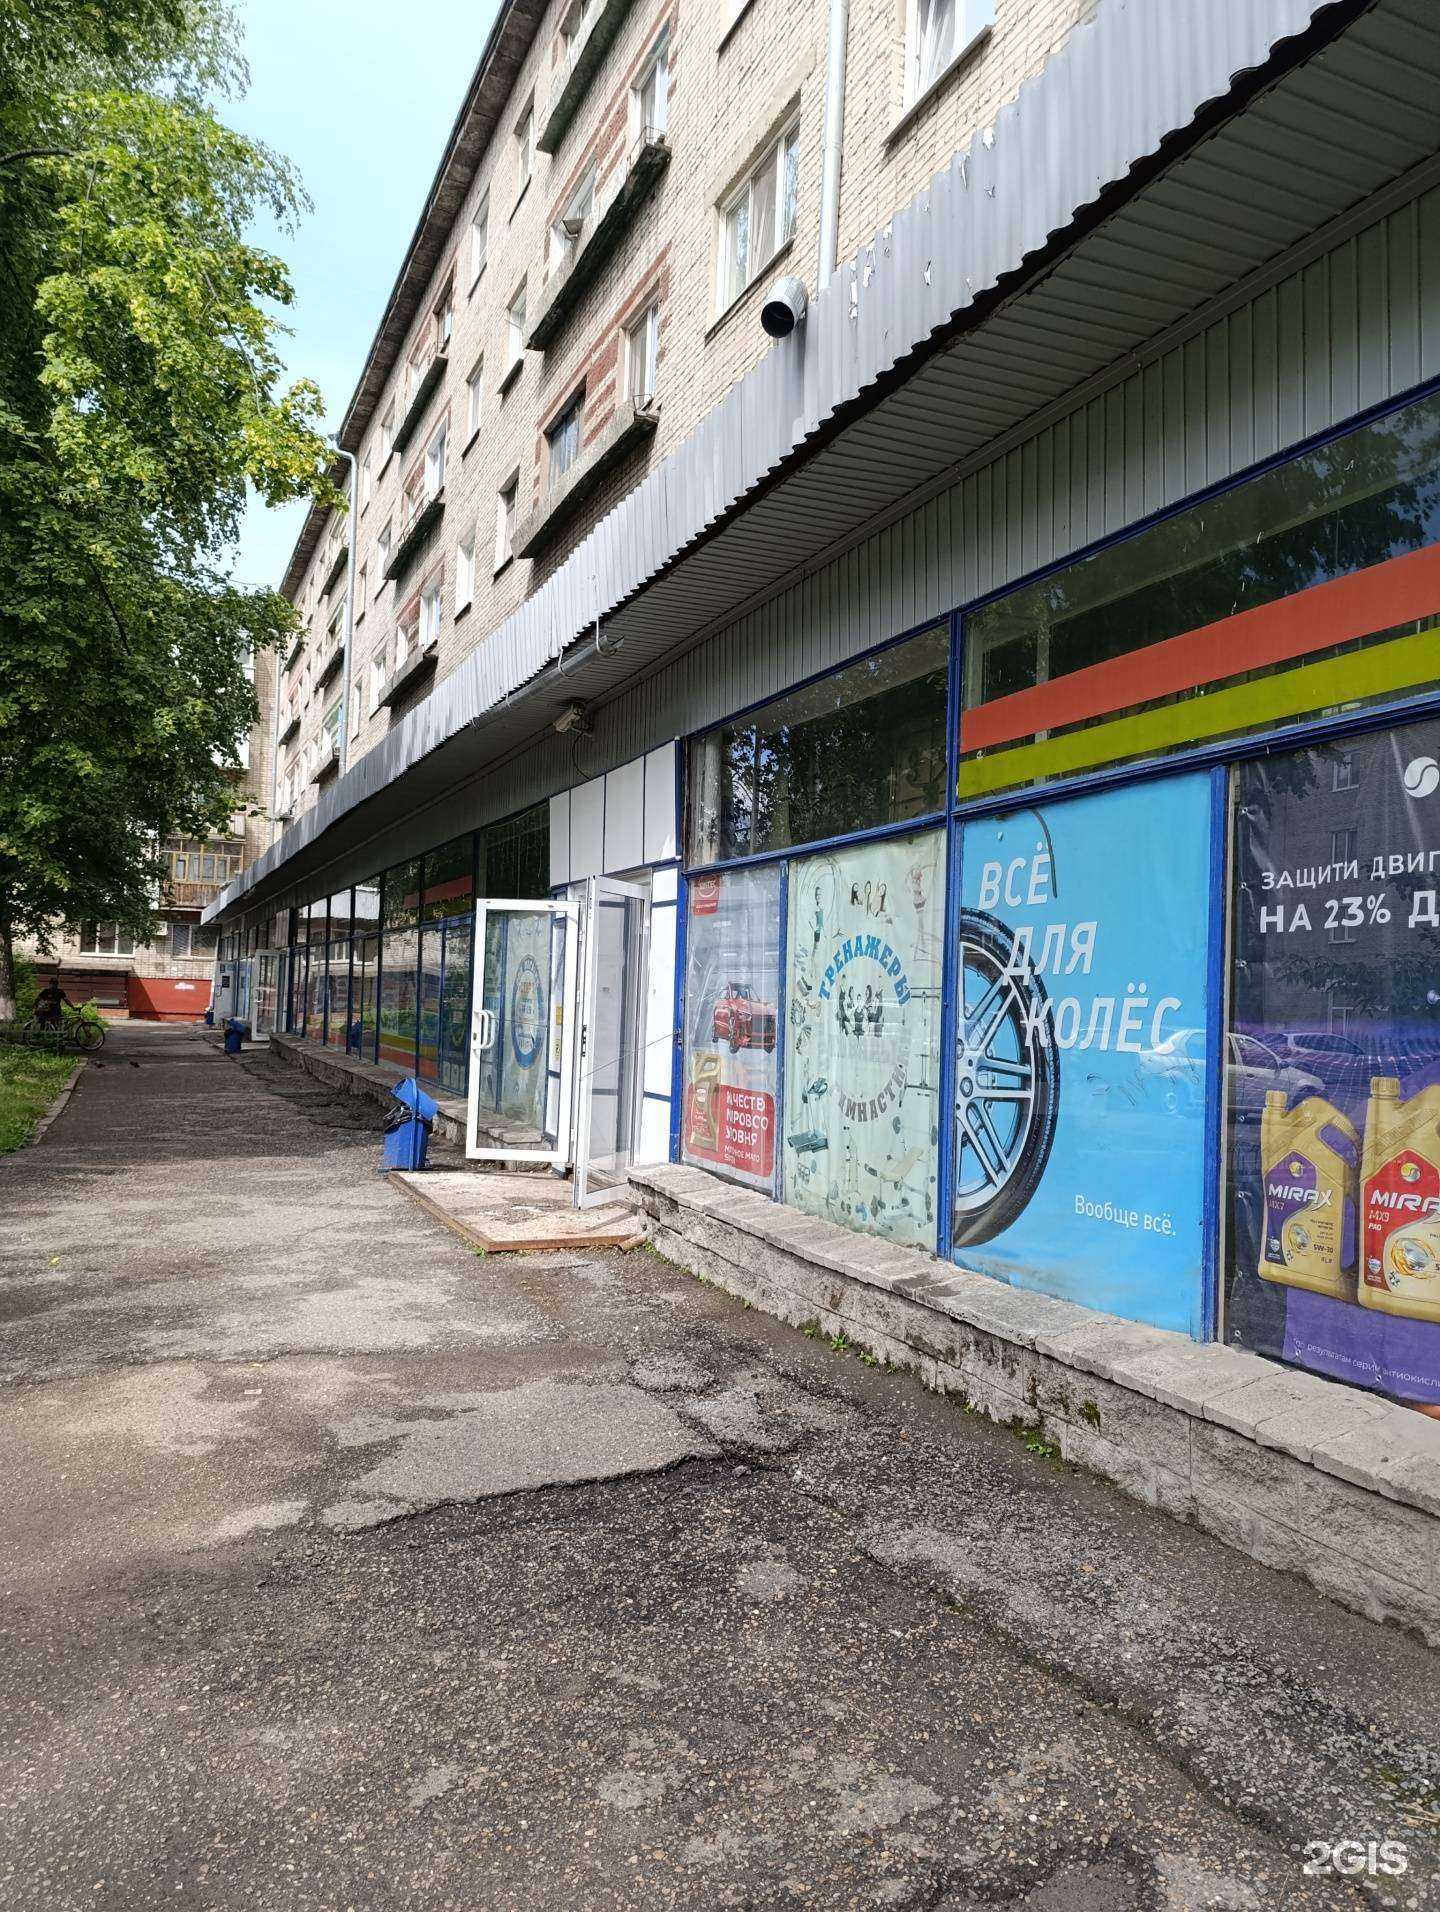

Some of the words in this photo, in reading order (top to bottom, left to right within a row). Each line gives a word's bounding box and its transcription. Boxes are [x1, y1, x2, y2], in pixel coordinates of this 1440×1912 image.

[979, 843, 1052, 910] ВСЁ
[1261, 859, 1359, 890] ЗАЩИТИ
[1259, 904, 1313, 934] НА
[1324, 893, 1391, 929] 23%
[1408, 890, 1440, 929] Д
[818, 935, 911, 1005] ТРЕНАЖЕРЫ
[1002, 921, 1099, 985] ДЛЯ
[1023, 981, 1183, 1054] КОЛЁС
[1074, 1195, 1138, 1230] Вообще
[1268, 1183, 1333, 1212] MIRAX
